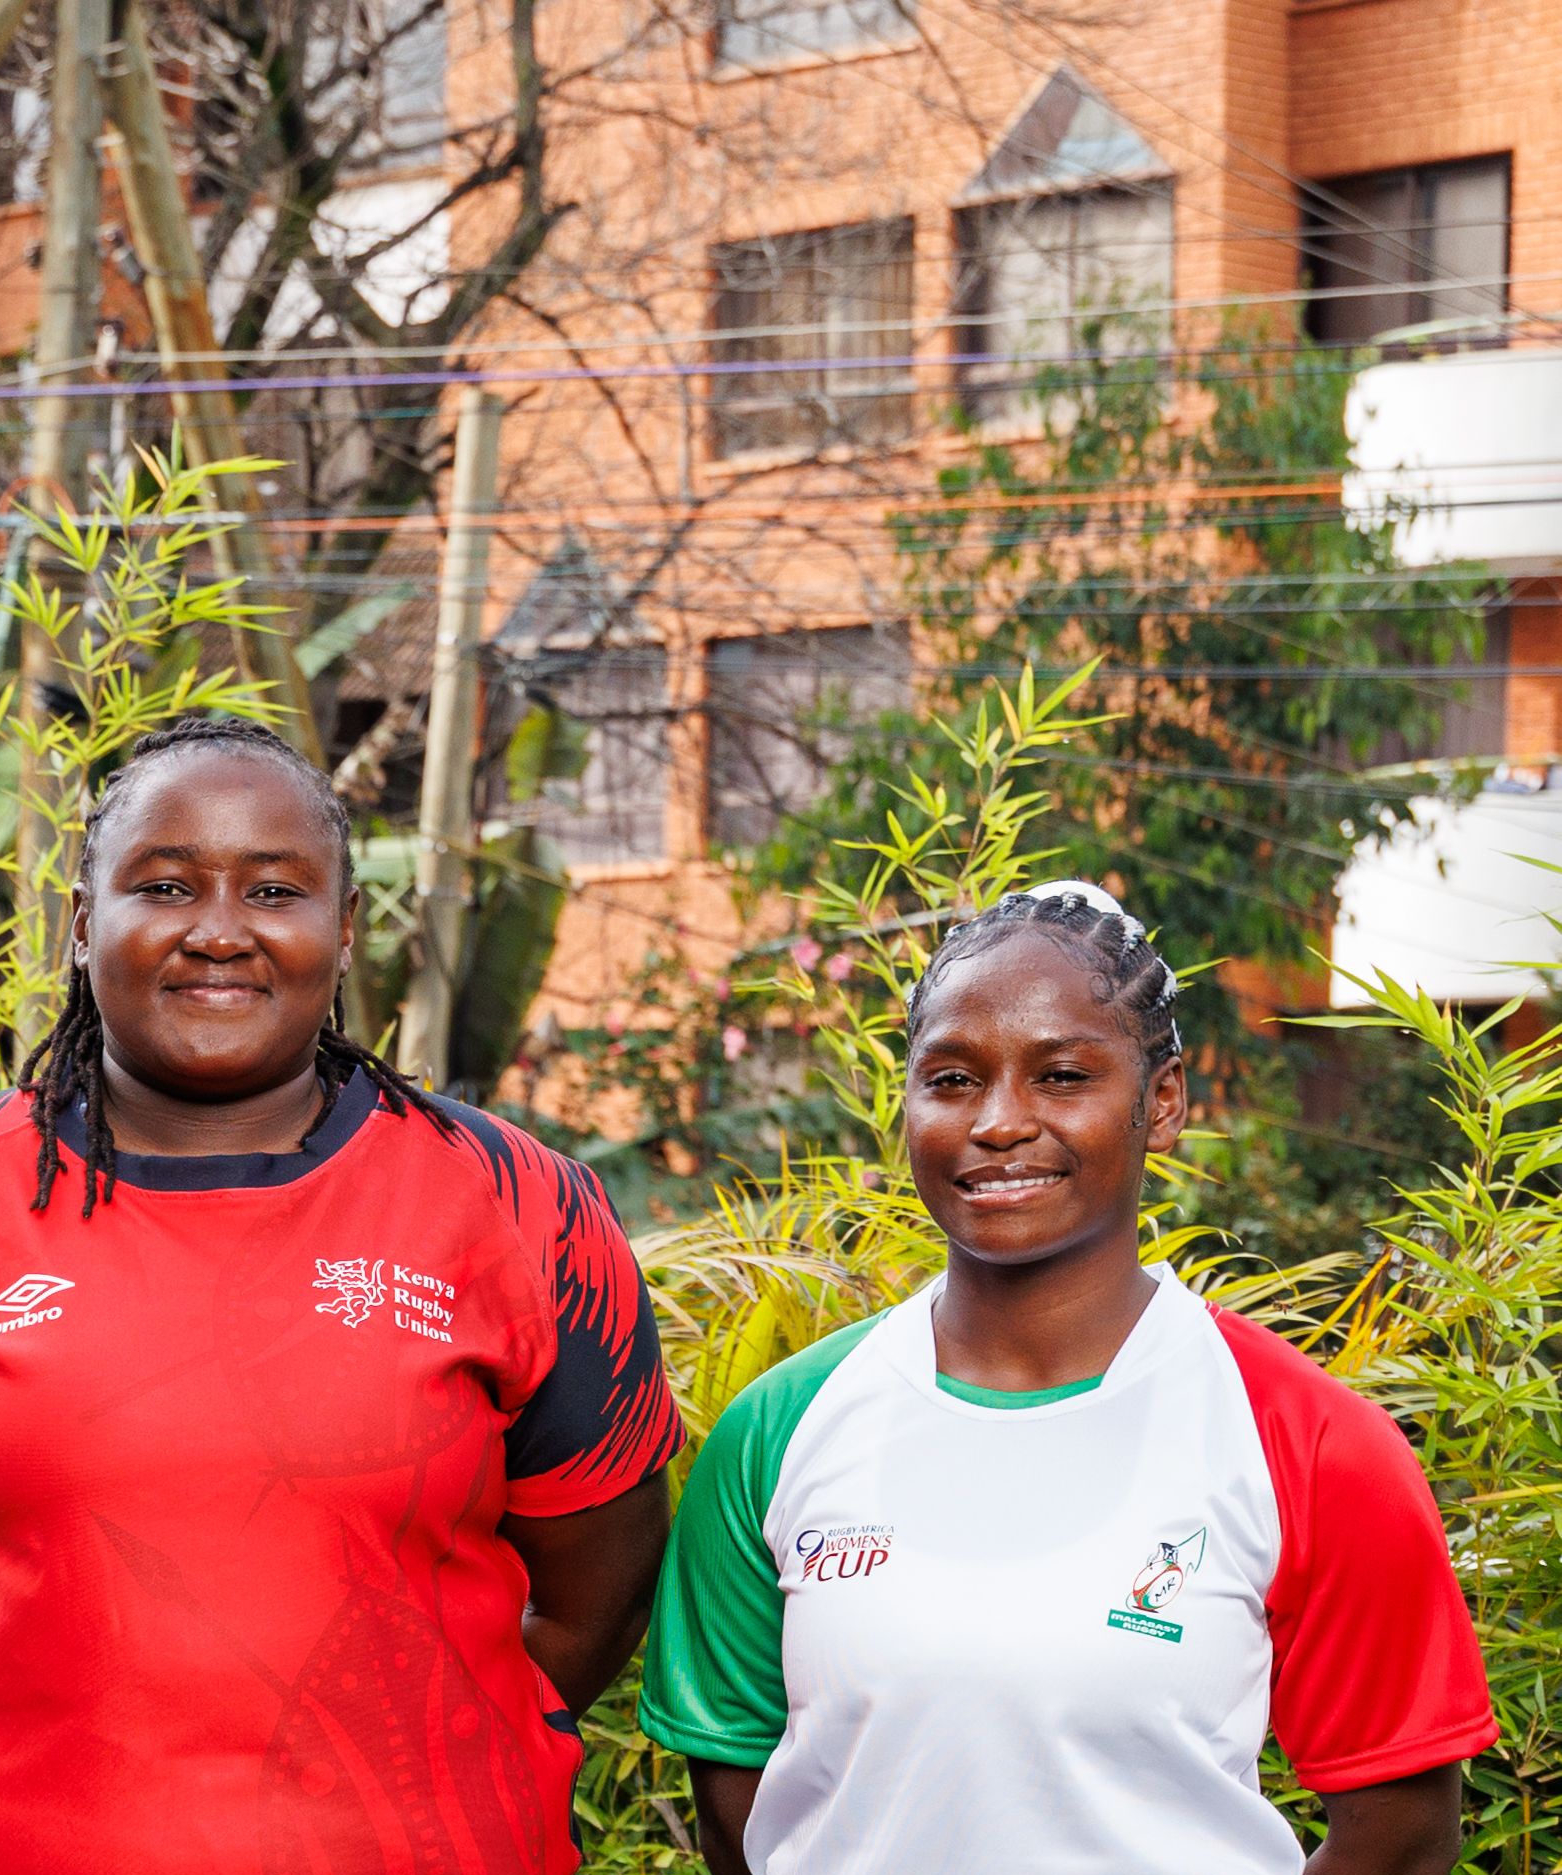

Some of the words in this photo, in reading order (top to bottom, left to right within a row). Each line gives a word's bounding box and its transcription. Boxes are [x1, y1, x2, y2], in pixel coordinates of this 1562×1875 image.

[393, 1264, 455, 1300] Kenya
[393, 1287, 454, 1327] Rugby
[394, 1310, 453, 1343] Union
[826, 1535, 893, 1552] WOMEN'S
[827, 1526, 857, 1537] RUGBY
[859, 1525, 895, 1534] AFRICA
[817, 1549, 889, 1582] CUP
[1110, 1613, 1180, 1634] MALAGASY
[1122, 1622, 1166, 1637] RUGBY
